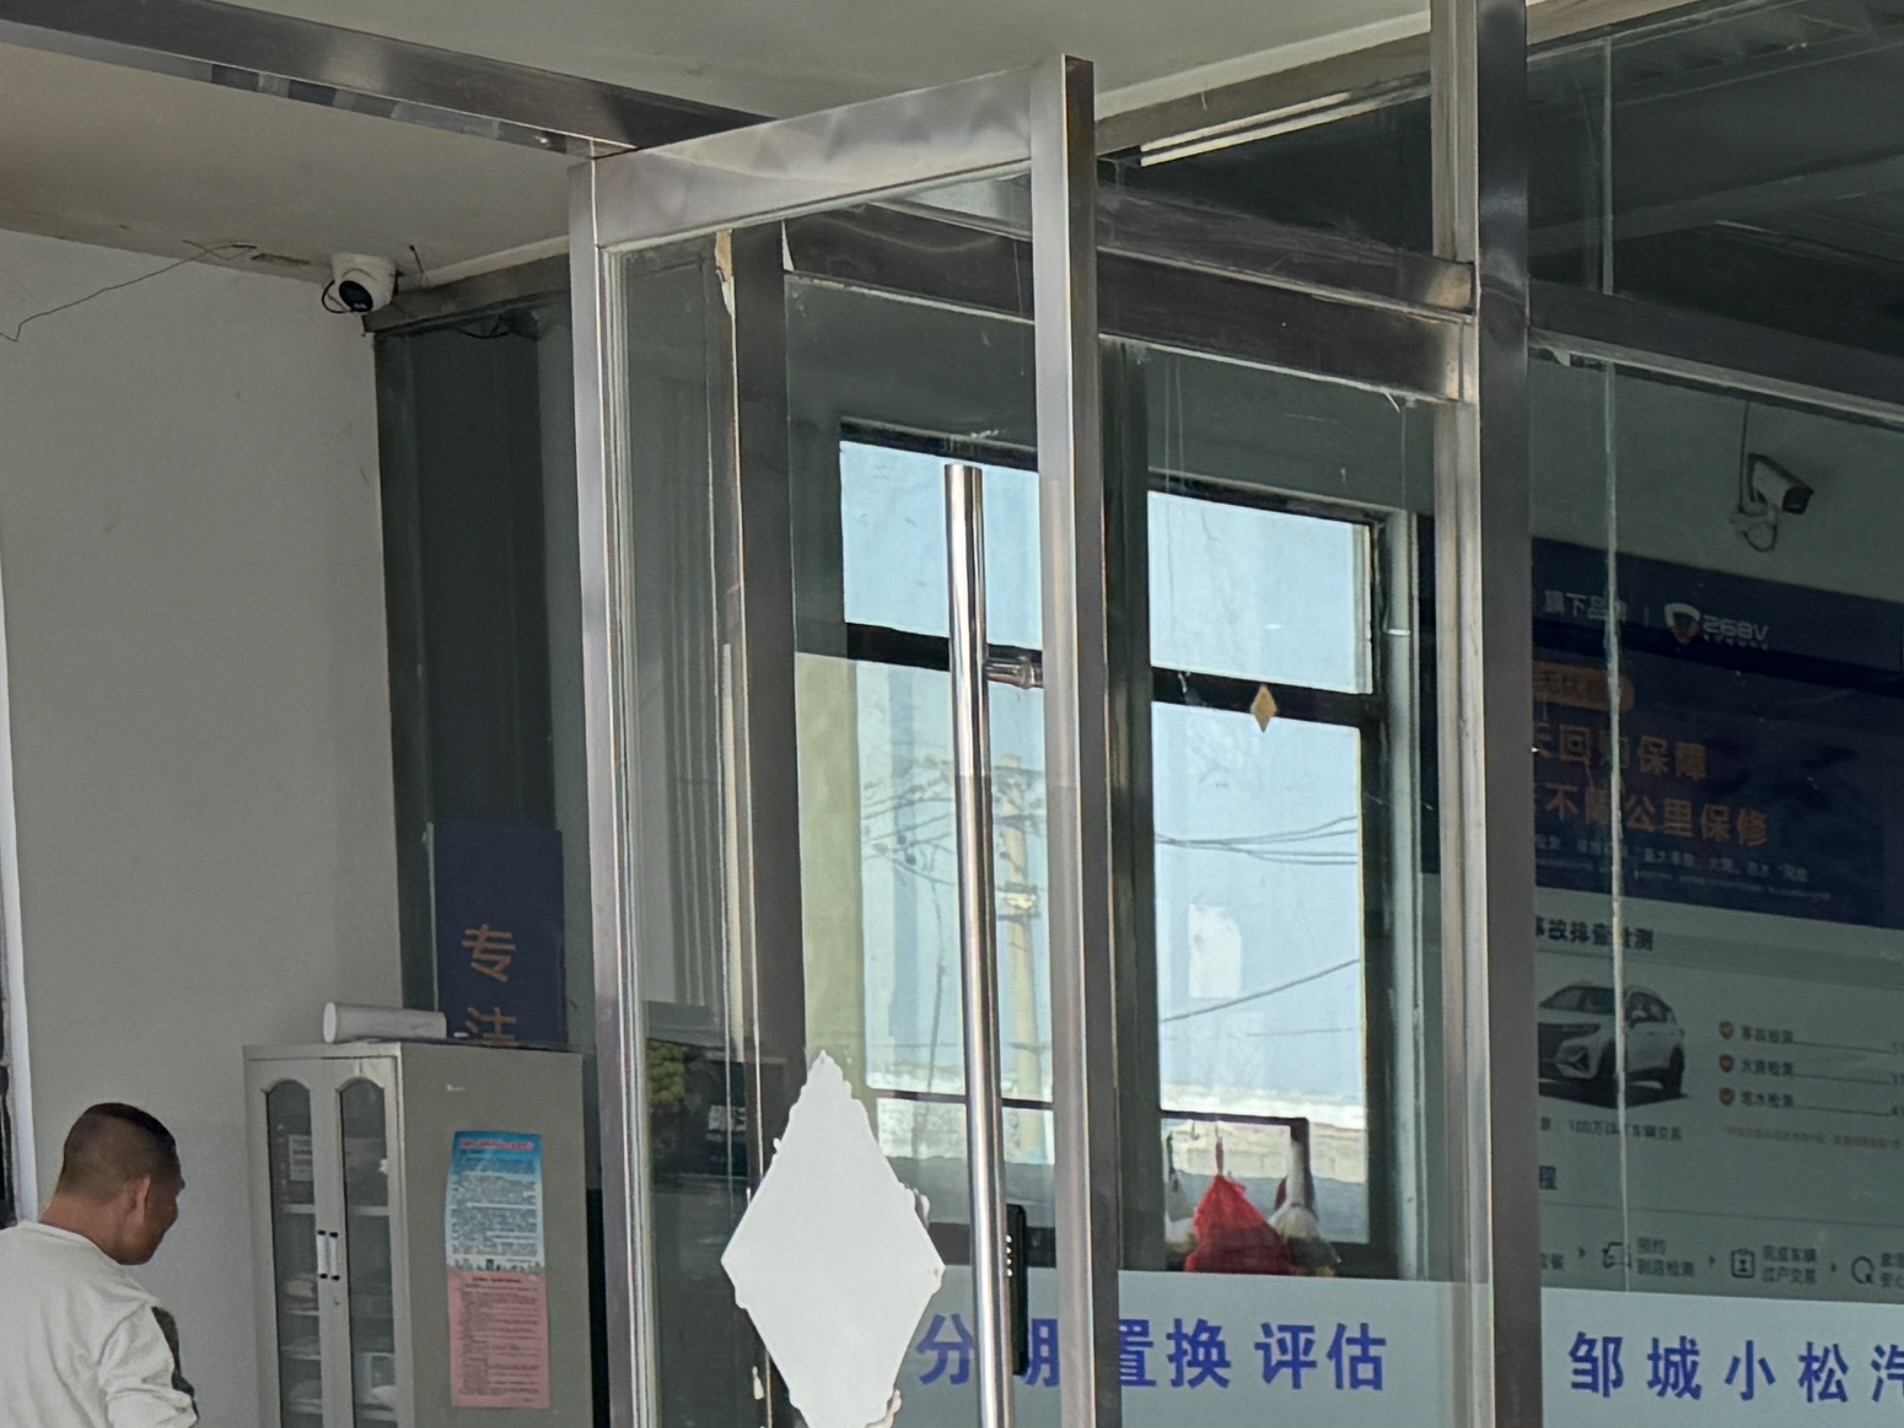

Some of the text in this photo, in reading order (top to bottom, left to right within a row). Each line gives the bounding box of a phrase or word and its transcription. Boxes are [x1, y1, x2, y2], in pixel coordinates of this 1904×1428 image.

[1535, 780, 1769, 848] 不限公里保修
[462, 923, 519, 1047] 专注
[1254, 1320, 1389, 1392] 评估
